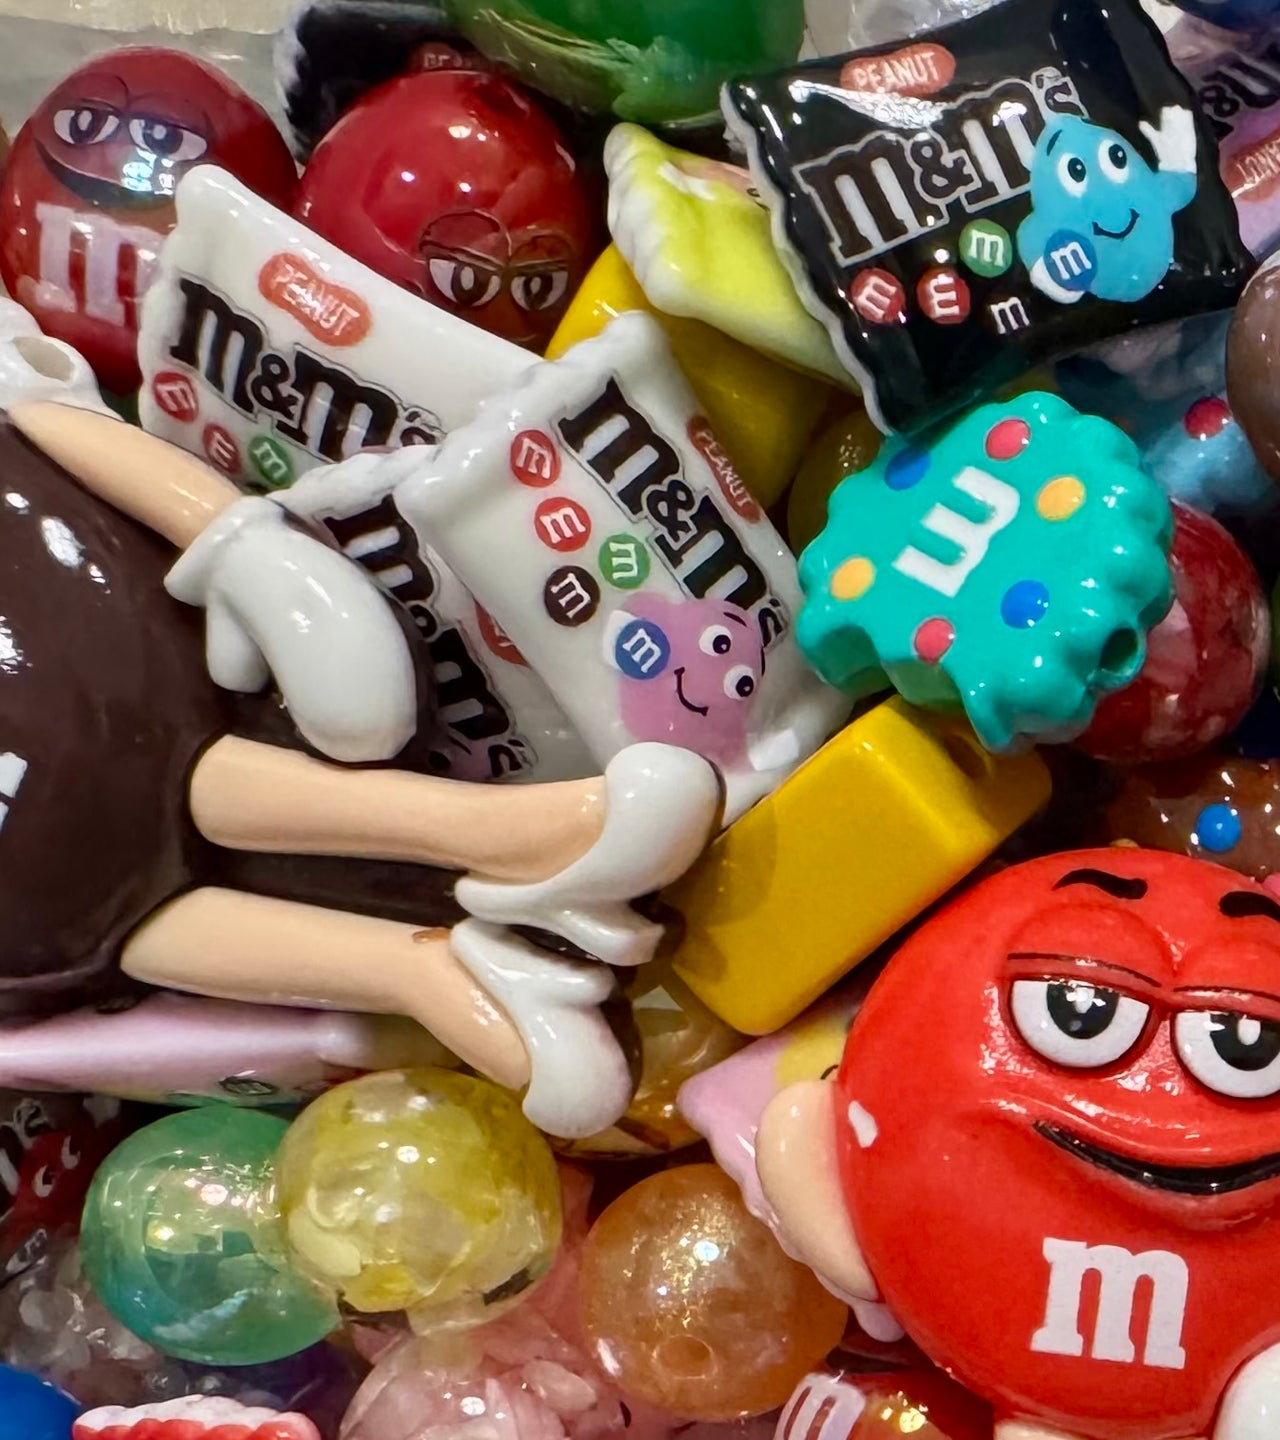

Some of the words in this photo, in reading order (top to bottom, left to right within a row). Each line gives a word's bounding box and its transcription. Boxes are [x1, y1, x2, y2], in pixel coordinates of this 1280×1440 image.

[854, 52, 938, 91] PEANUT
[971, 229, 1004, 270] m
[1051, 242, 1090, 281] m
[854, 275, 897, 317] m
[928, 272, 961, 319] m
[991, 298, 1030, 334] m
[160, 379, 196, 417] m
[206, 428, 236, 470] m
[255, 444, 288, 483] m
[518, 438, 553, 479] m
[541, 505, 586, 545] m
[892, 465, 1020, 598] m
[609, 542, 640, 580] m
[552, 573, 591, 618] m
[622, 628, 663, 673] m
[1030, 1237, 1189, 1369] m
